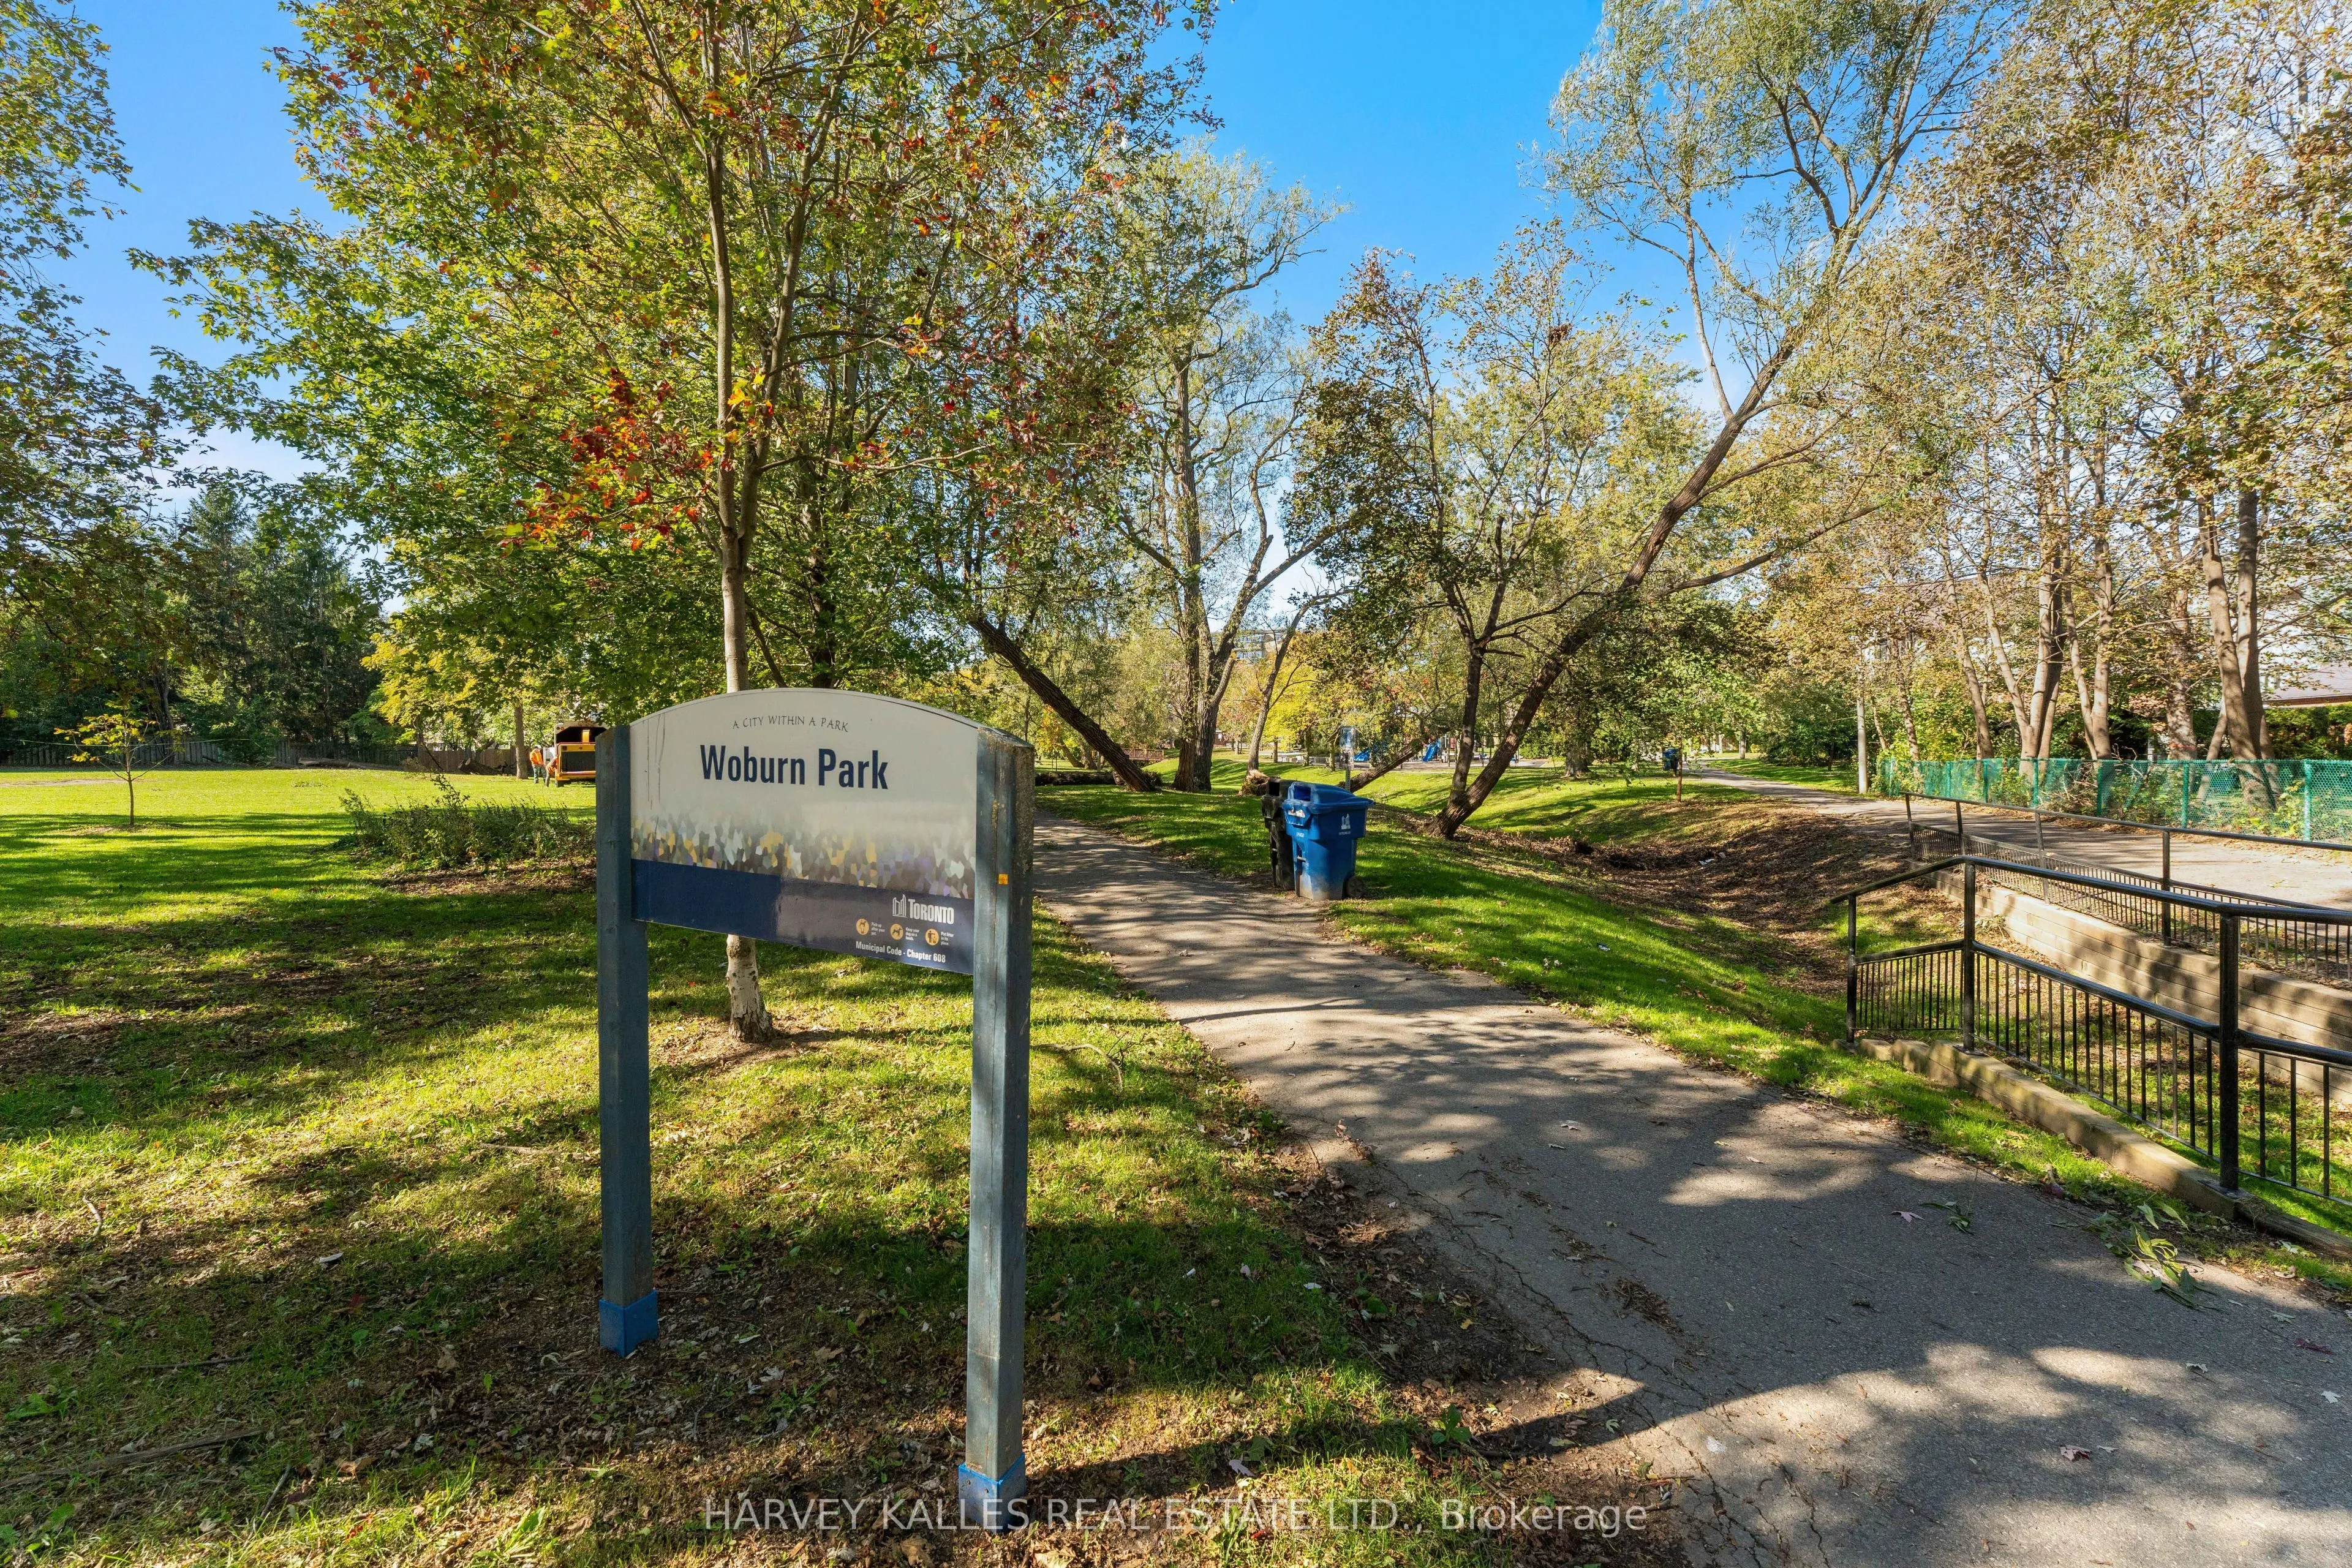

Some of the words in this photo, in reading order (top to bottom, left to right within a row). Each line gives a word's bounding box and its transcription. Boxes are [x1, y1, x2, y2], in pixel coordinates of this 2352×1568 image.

[733, 719, 740, 729] A
[743, 716, 764, 728] CITY
[768, 715, 805, 726] WITHIN
[809, 717, 816, 726] A
[821, 717, 849, 733] PARK
[700, 744, 805, 785] Woburn
[818, 748, 889, 790] Park
[908, 898, 955, 925] TORONTO
[856, 941, 885, 954] Municipal
[886, 946, 902, 956] Code
[907, 949, 932, 961] Chapter
[933, 953, 946, 963] 608
